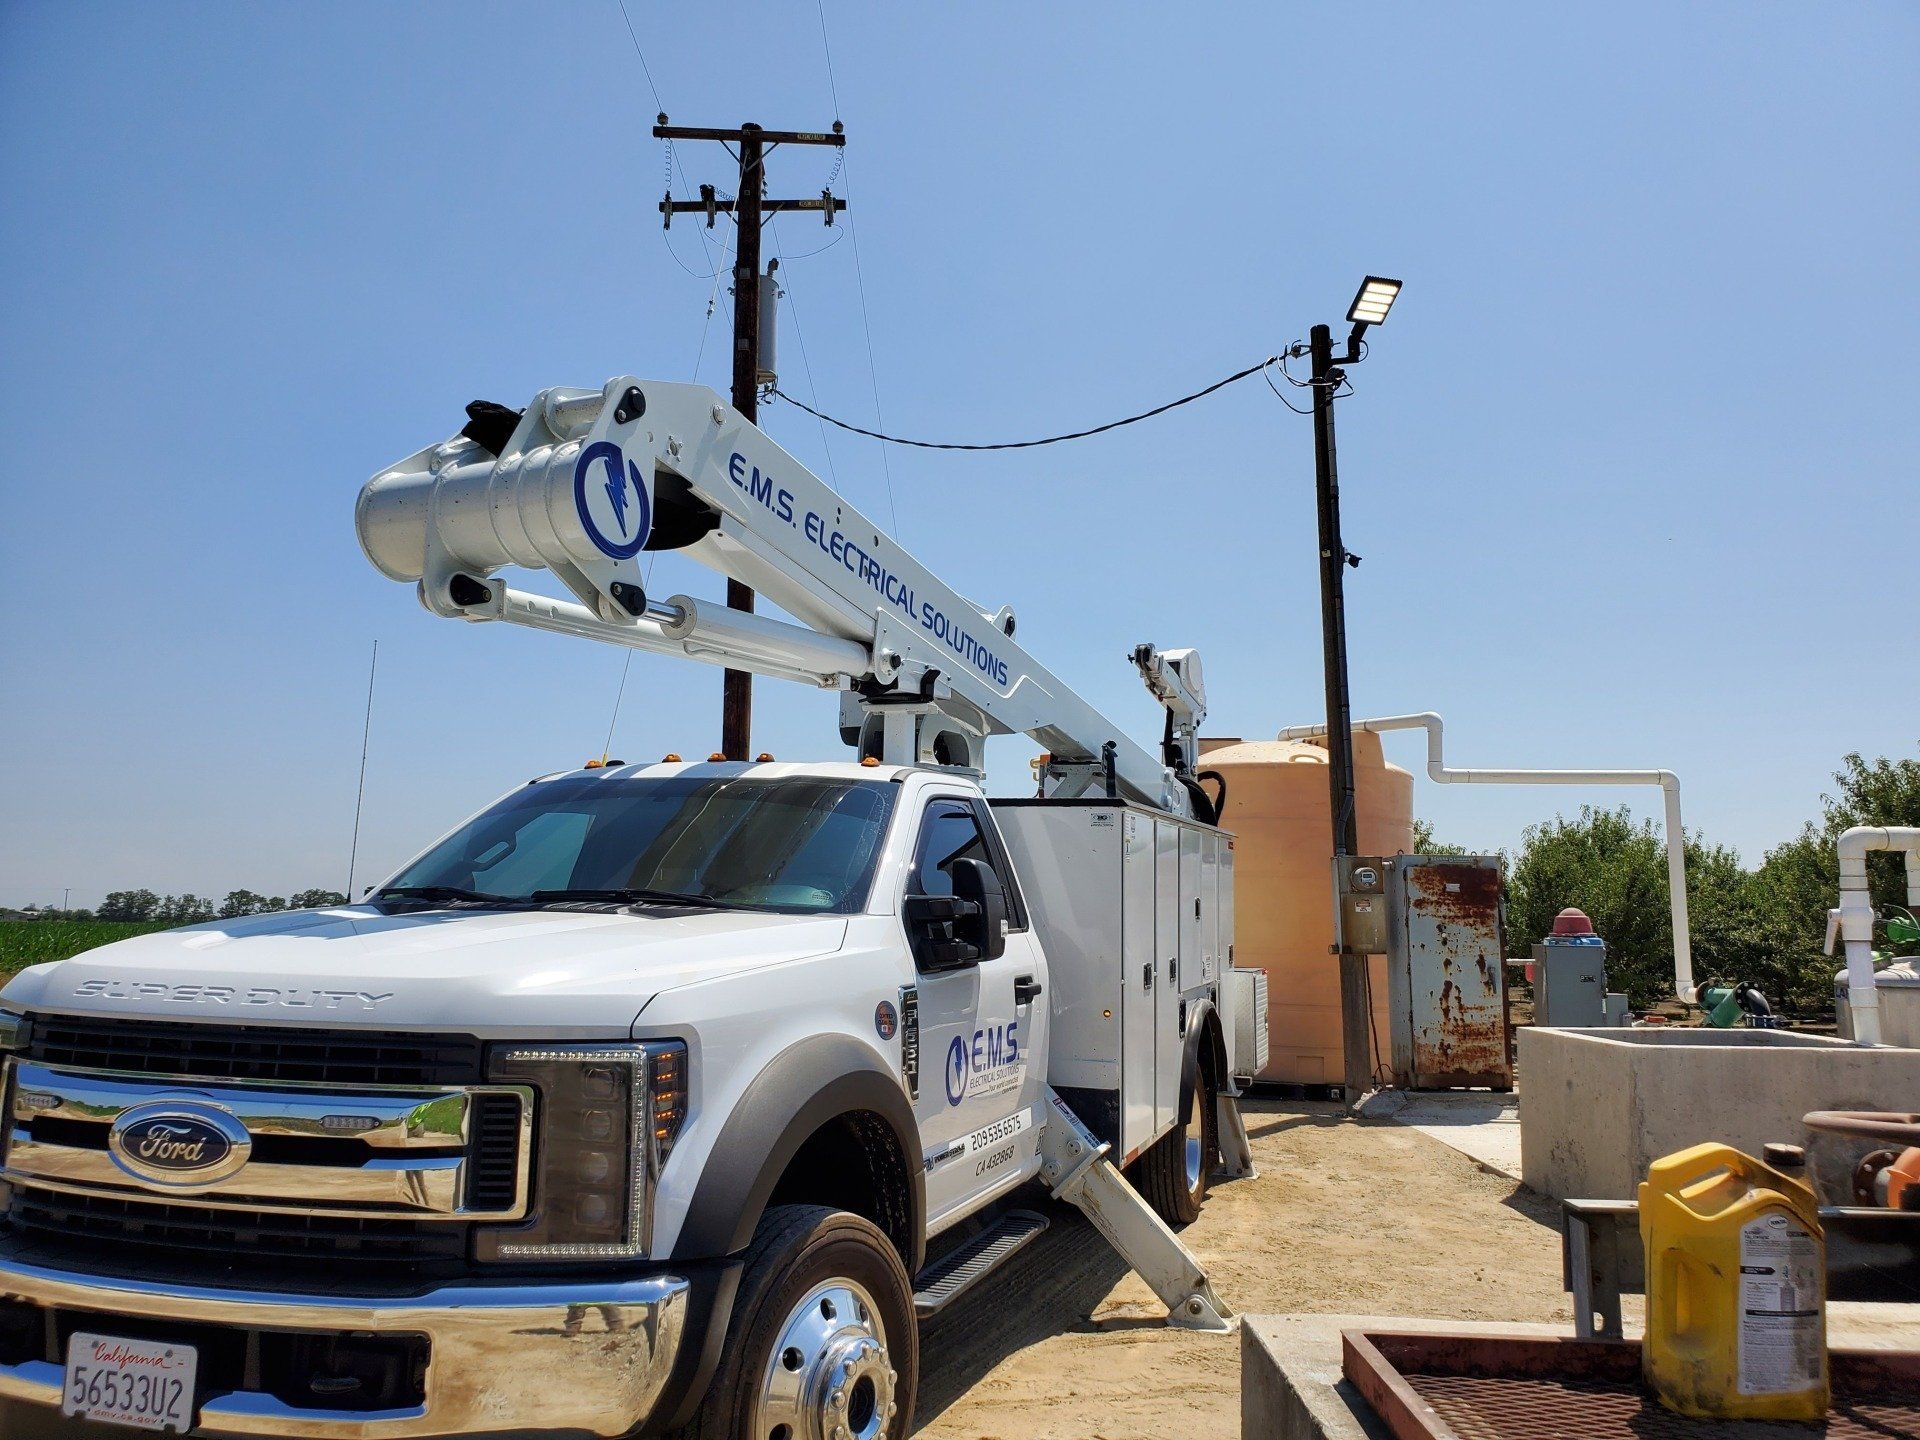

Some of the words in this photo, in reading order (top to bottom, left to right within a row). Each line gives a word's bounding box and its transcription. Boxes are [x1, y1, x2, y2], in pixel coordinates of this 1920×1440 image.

[728, 452, 797, 529] E.M.S.
[804, 511, 918, 620] ELECTRICAL
[921, 602, 1008, 686] SOLUTIONS
[73, 979, 236, 1004] SUPER
[240, 987, 395, 1010] DUTY
[139, 1124, 207, 1161] Ford
[94, 1342, 172, 1370] California
[72, 1366, 184, 1419] 56533U2
